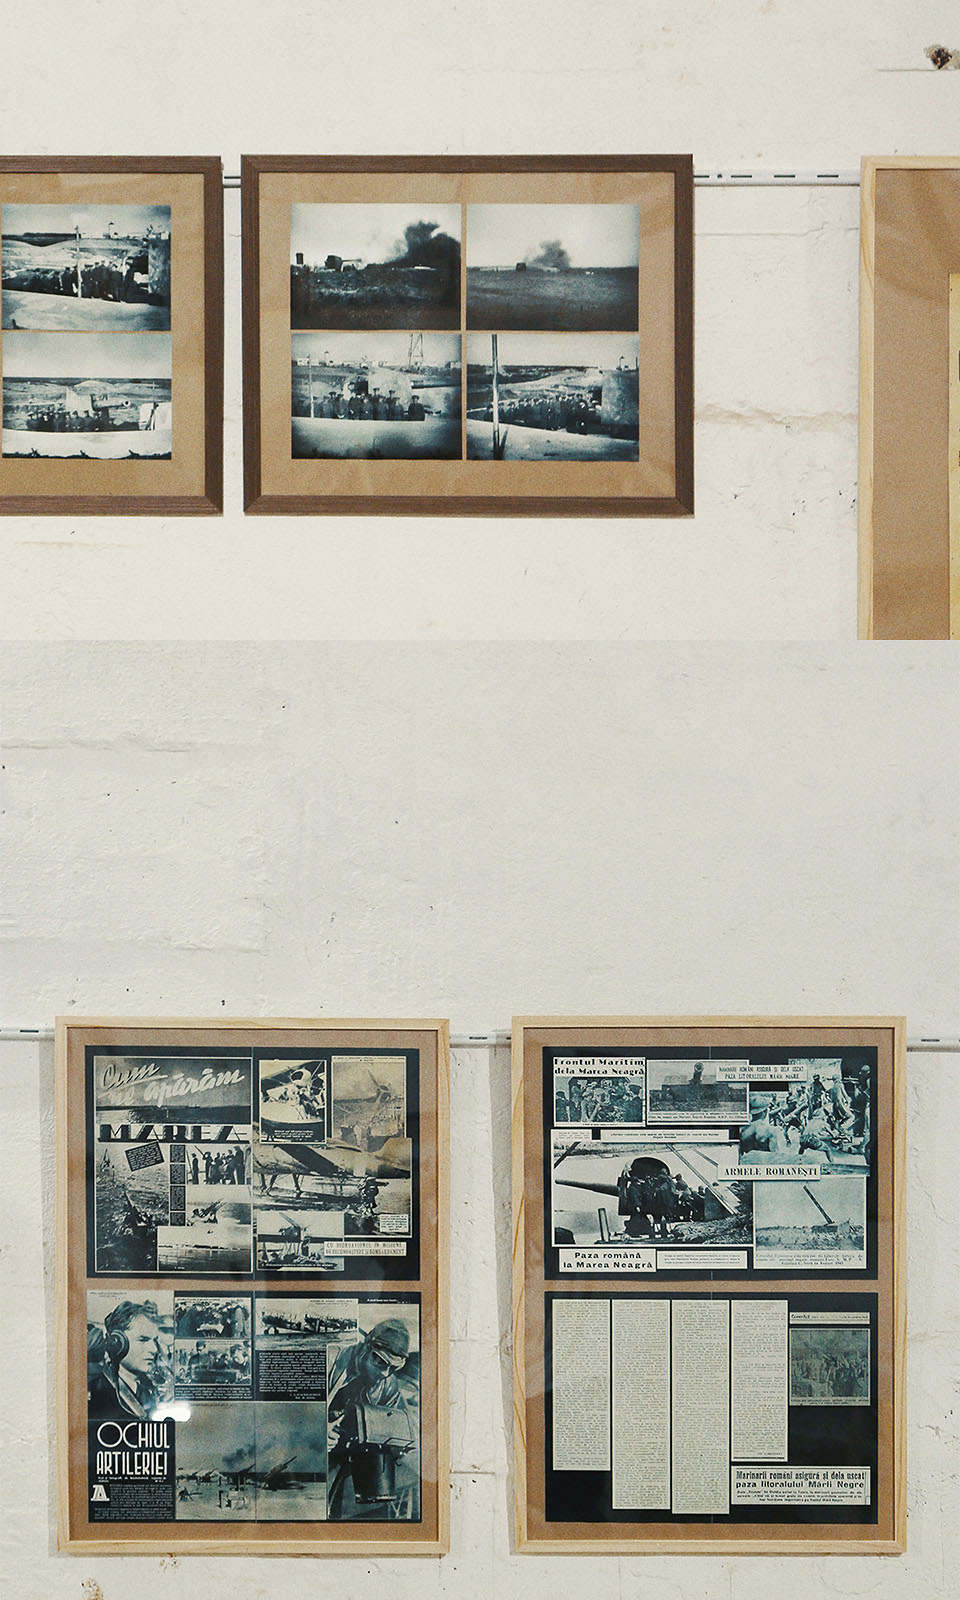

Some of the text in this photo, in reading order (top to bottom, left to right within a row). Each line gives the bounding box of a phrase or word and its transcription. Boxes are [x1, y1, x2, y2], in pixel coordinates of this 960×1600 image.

[98, 1124, 250, 1143] MAREA
[725, 1168, 761, 1176] ARMELE
[97, 1421, 170, 1449] OCHIUL
[96, 1451, 168, 1476] ARTILERIEI
